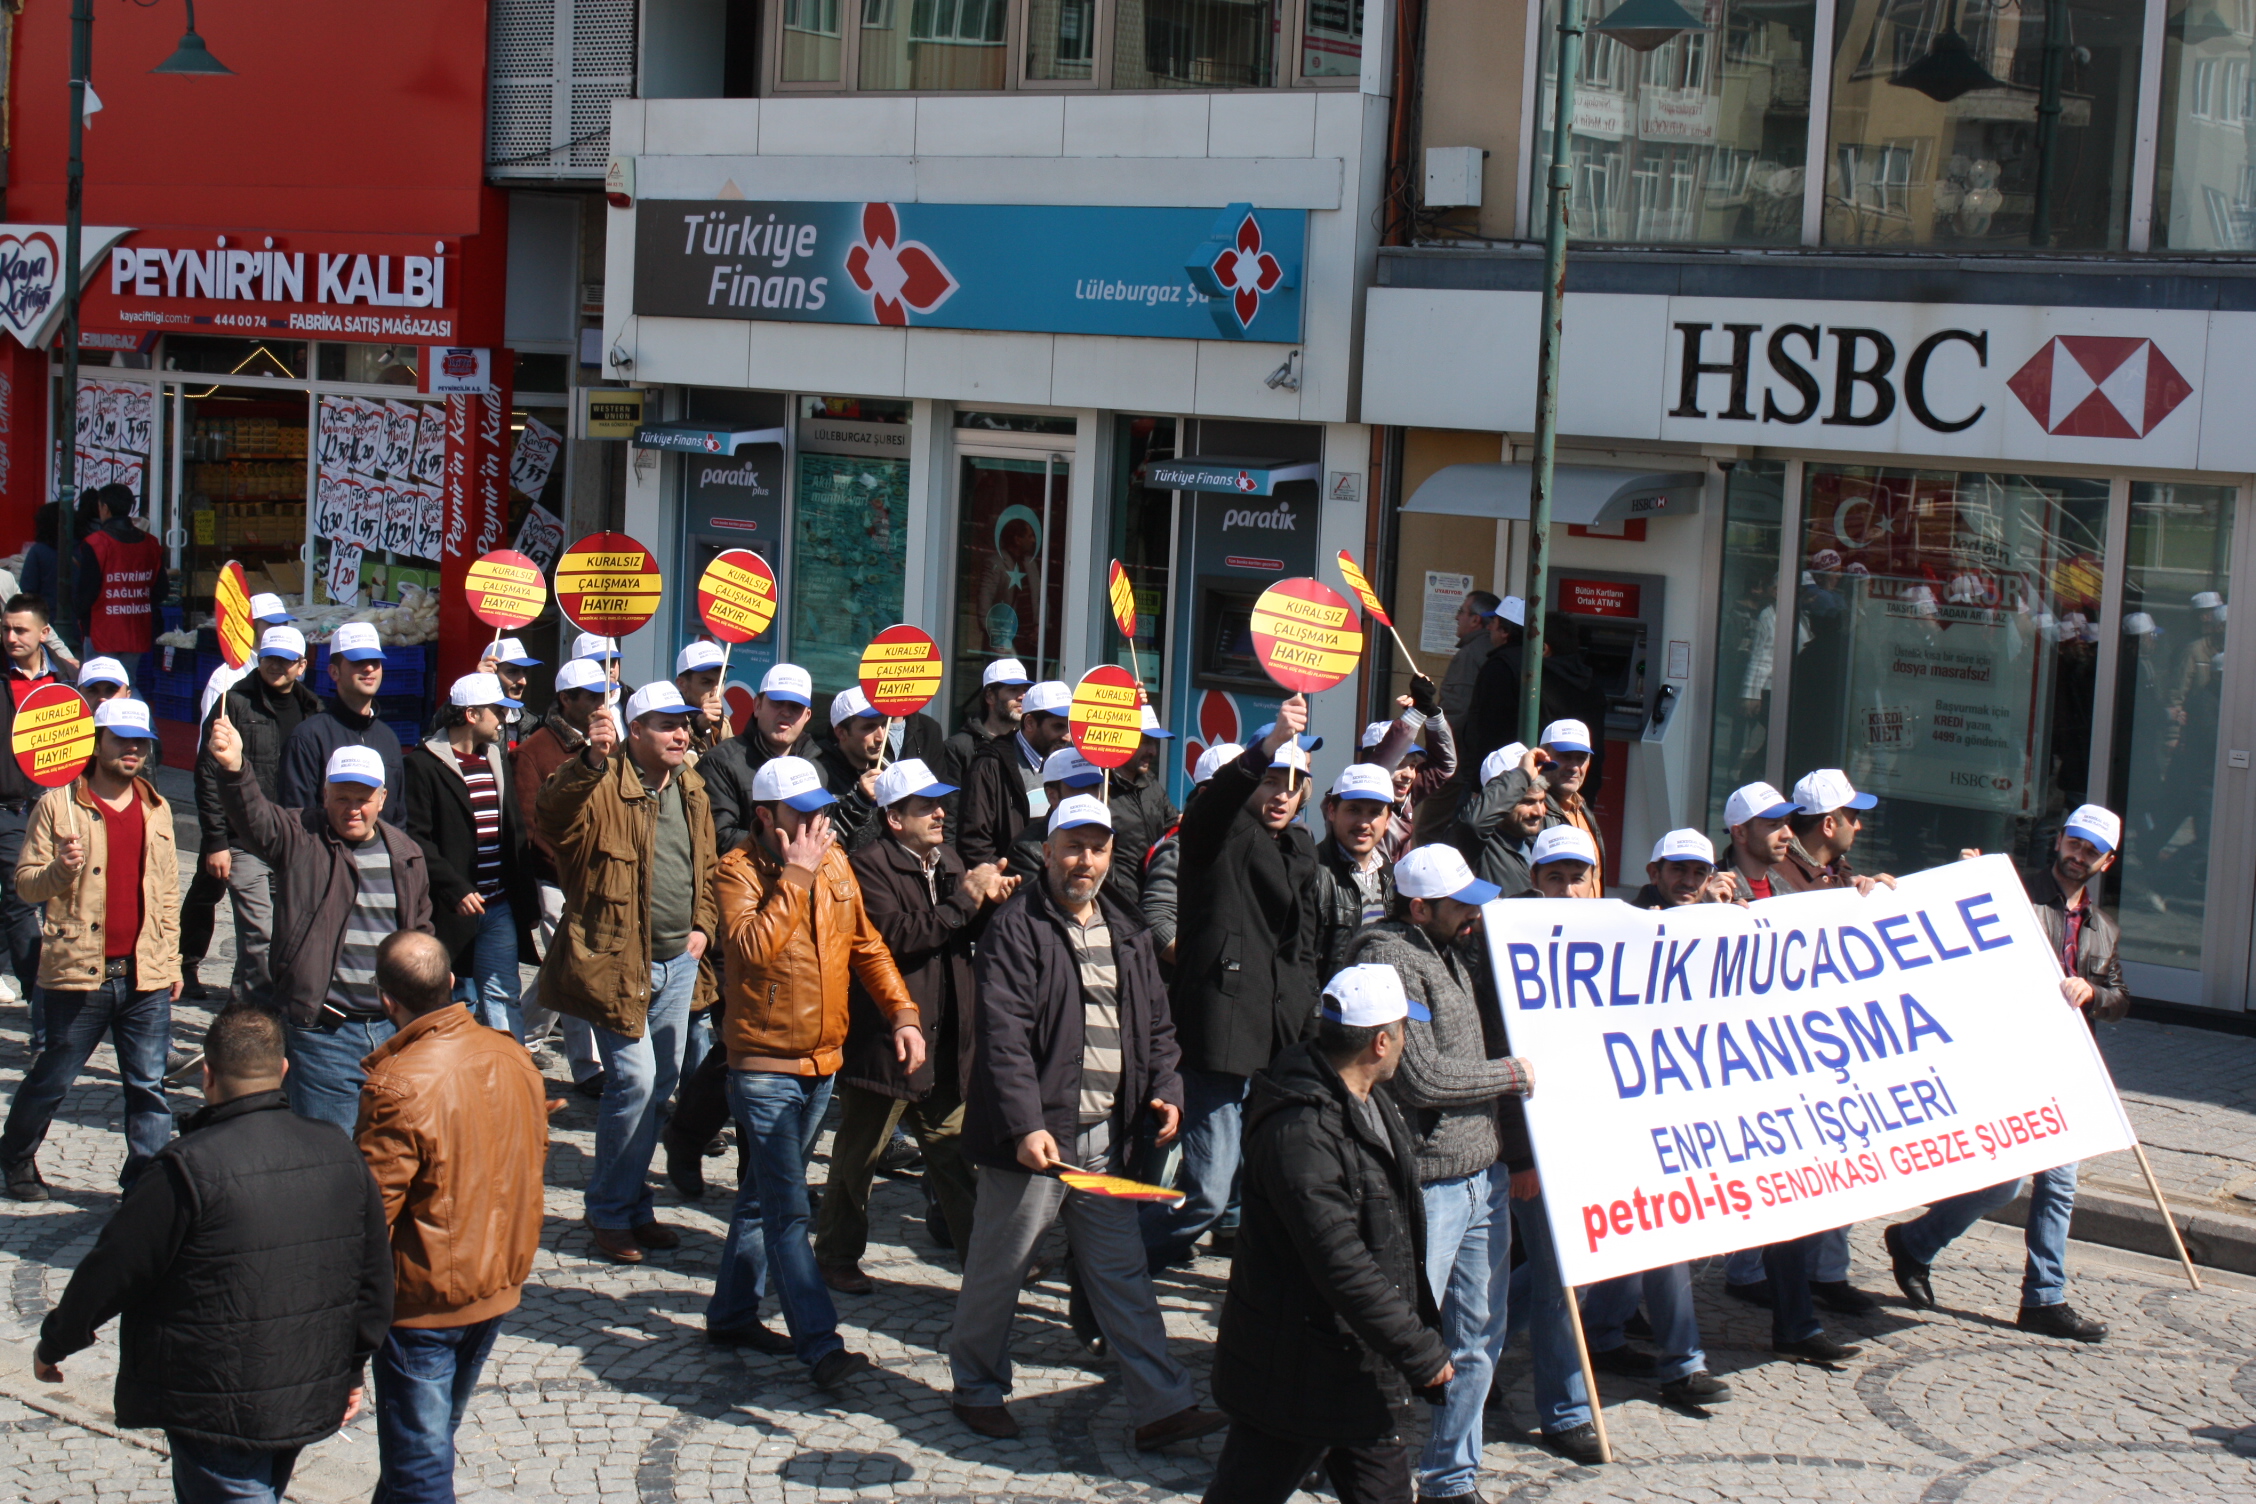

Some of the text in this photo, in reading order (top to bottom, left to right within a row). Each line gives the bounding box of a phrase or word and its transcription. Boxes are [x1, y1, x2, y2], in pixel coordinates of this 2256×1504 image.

[684, 211, 817, 268] Türkiye
[0, 247, 46, 289] Kaya
[112, 235, 444, 308] PEYNİR'İN KALBİ
[708, 264, 828, 310] Finans
[1076, 279, 1181, 306] Lüleburgaz
[120, 310, 451, 337] kayaciftligi.com.tr 444 00 74 FABRİKA SATIŞ MAĞAZASI
[1669, 320, 1988, 433] HSBC
[593, 405, 631, 413] WESTERN
[604, 412, 631, 420] UNION
[449, 393, 466, 446] Kalb
[640, 431, 703, 447] Türkiye Finans
[814, 428, 905, 447] LÜLEBURGAZ ŞUBESİ
[700, 461, 759, 488] paratik
[1154, 469, 1234, 486] Türkiye Finans
[752, 486, 769, 497] plus
[446, 452, 467, 557] Peynir'in
[477, 453, 503, 555] Peynir'in
[1631, 497, 1655, 512] HSBC
[1222, 502, 1297, 531] paratik
[587, 556, 640, 567] KURALSIZ
[106, 569, 152, 583] DEVRİMCİ
[492, 566, 534, 581] KURALSIZ
[727, 568, 768, 591] KURALSIZ
[483, 581, 531, 596] ÇALIŞMAYA
[578, 578, 640, 591] ÇALIŞMAYA
[1575, 586, 1624, 598] Bütün Kartların
[484, 595, 520, 611] HAYIR!
[583, 599, 628, 611] HAYIR!
[715, 585, 761, 609] ÇALIŞMAYA
[1577, 597, 1621, 608] Ortak ATM'si
[106, 602, 152, 615] SENDİKASI
[712, 603, 749, 623] HAYIR!
[1286, 601, 1343, 623] KURALSIZ
[1887, 603, 1917, 615] TAKSİTİ
[1274, 622, 1338, 645] ÇALIŞMAYA
[885, 646, 927, 656] KURALSIZ
[1274, 645, 1323, 667] HAYIR!
[1894, 645, 1991, 667] Üstelik kısa bir süre için
[876, 665, 925, 677] ÇALIŞMAYA
[1313, 672, 1339, 680] PLATFORMU
[1893, 659, 1990, 682] dosya masrafsız!
[878, 683, 915, 695] HAYIR!
[1095, 688, 1134, 702] KURALSIZ
[35, 703, 78, 723] KURALSIZ
[1086, 709, 1132, 723] ÇALIŞMAYA
[1869, 711, 1904, 725] KREDİ
[1936, 699, 2010, 719] Başvurmak için
[1933, 713, 1993, 733] KREDİ yazın,
[30, 724, 79, 748] ÇALIŞMAYA
[1087, 731, 1122, 744] HAYIR!
[1869, 724, 1904, 743] NET
[1933, 730, 2010, 750] 4499'a gönderin.
[36, 746, 72, 766] HAYIR!
[1951, 771, 1989, 789] HSBC
[1507, 892, 2014, 1010] BİRLİK MÜCADELE
[1603, 992, 1954, 1099] DAYANIŞMA
[1650, 1066, 1958, 1175] ENPLAST İŞÇİLERİ
[1582, 1096, 2068, 1253] petrol-iş SENDİKASI GEBZE ŞUBESİ
